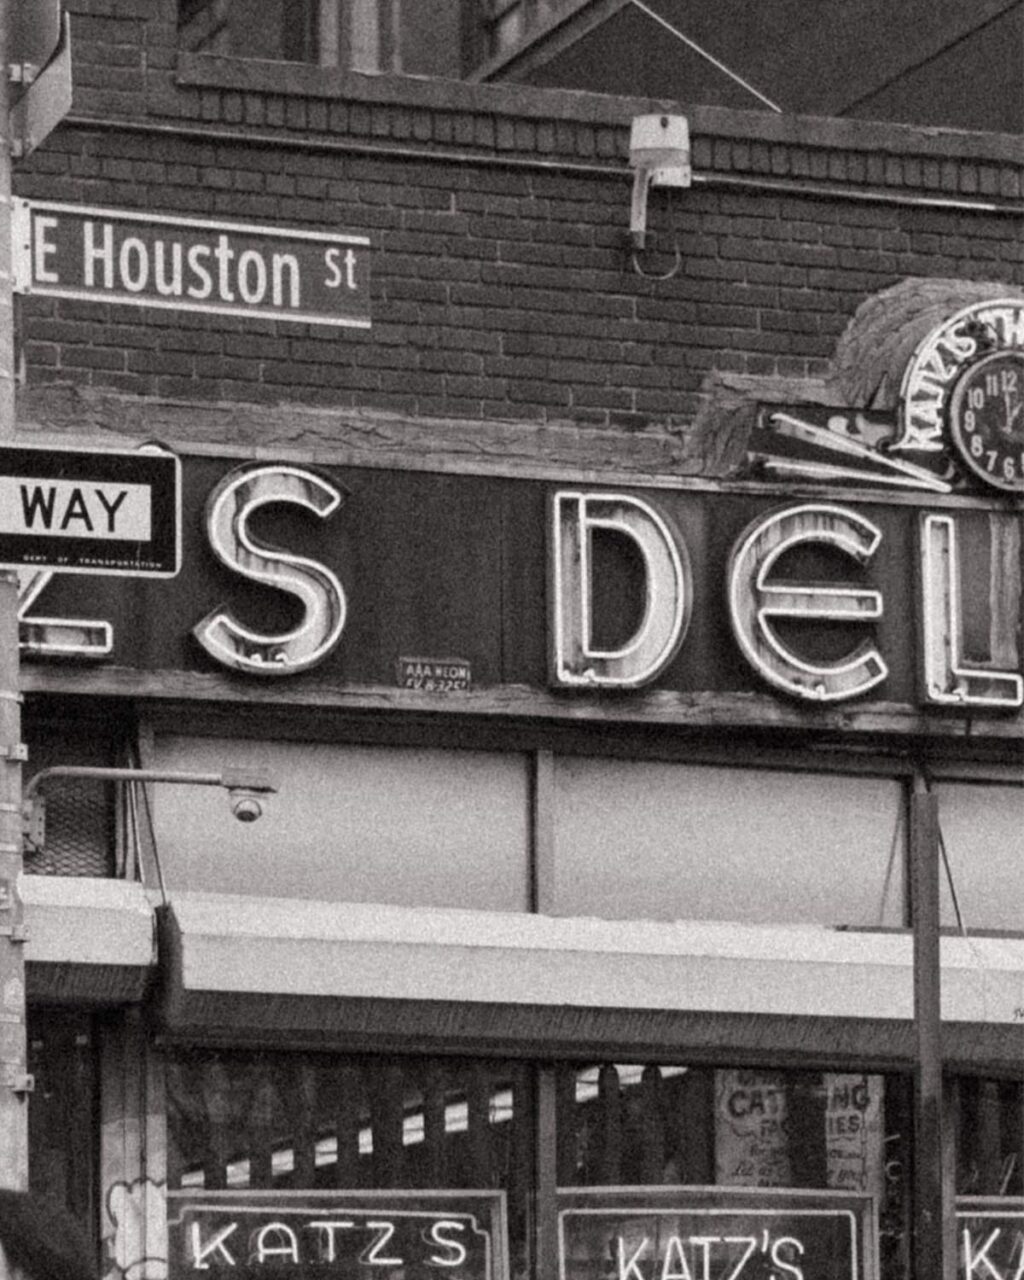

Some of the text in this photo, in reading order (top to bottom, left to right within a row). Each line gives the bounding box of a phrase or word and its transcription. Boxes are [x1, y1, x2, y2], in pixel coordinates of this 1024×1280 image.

[33, 216, 357, 308] E Houston St
[985, 374, 998, 396] 11
[1001, 370, 1018, 392] 12
[967, 388, 984, 409] 10
[964, 410, 975, 432] 9
[970, 435, 983, 457] 8
[986, 451, 998, 472] 7
[1003, 457, 1015, 479] 6
[19, 482, 129, 534] WAY
